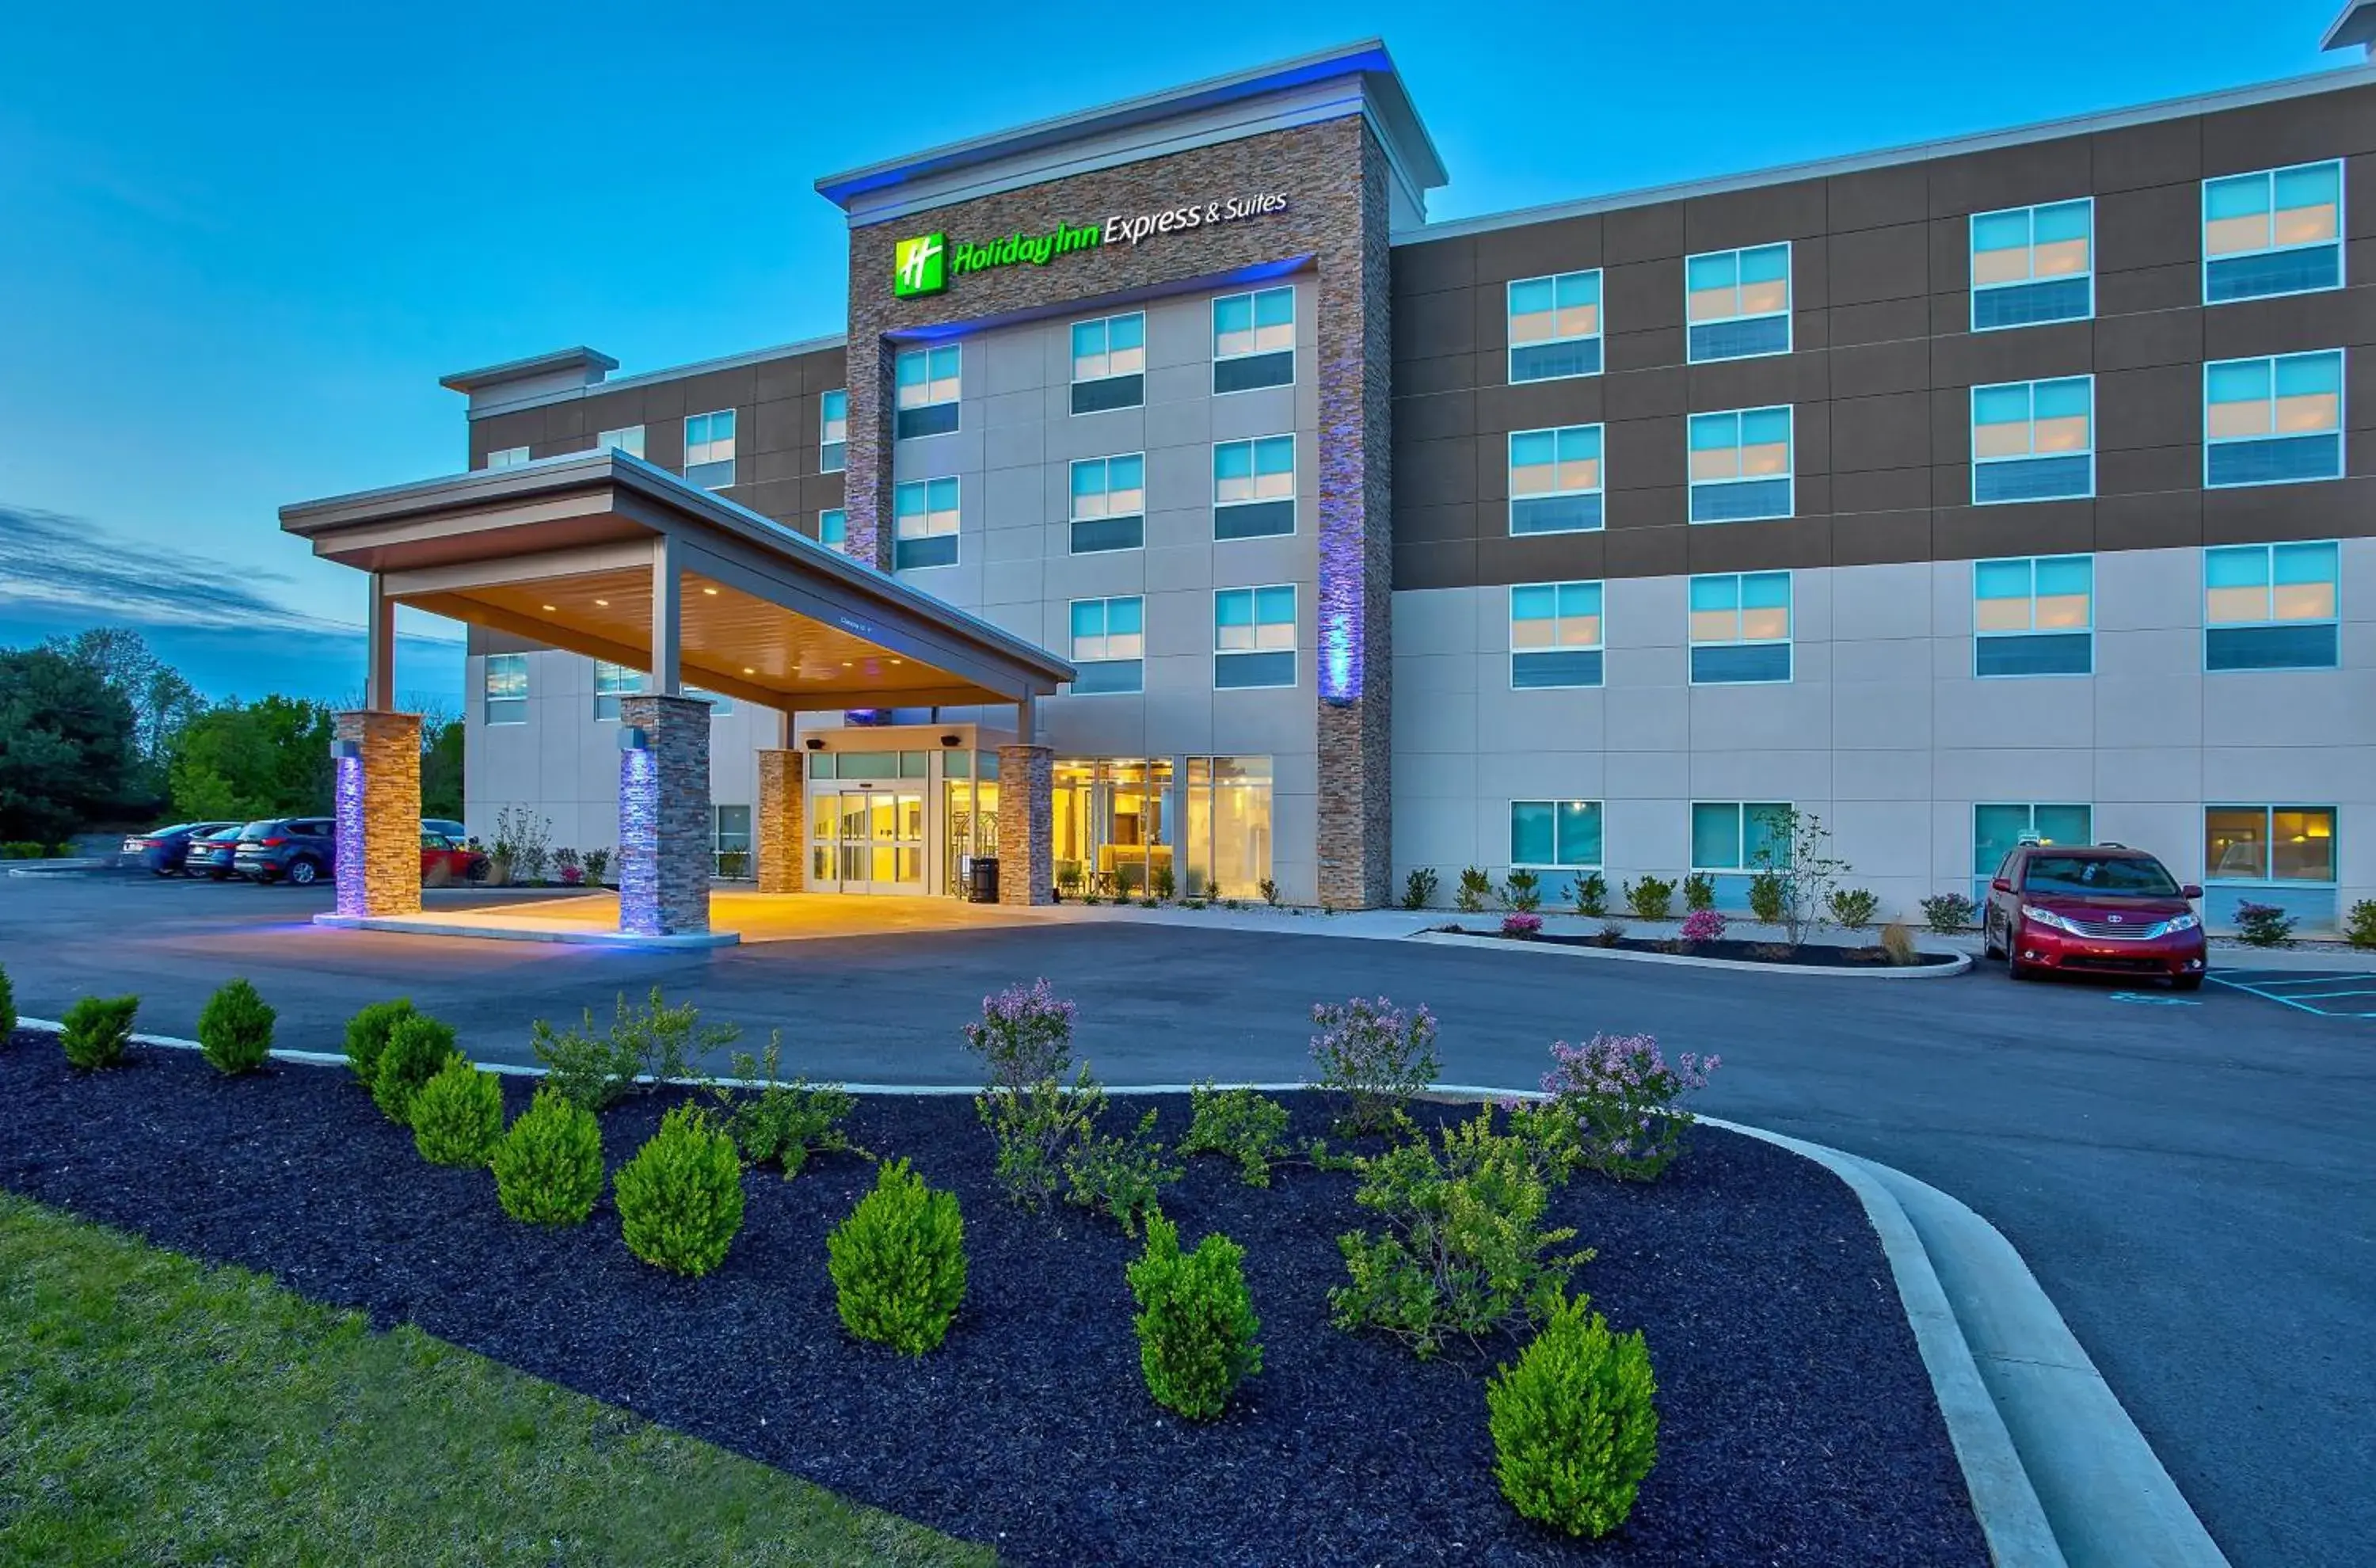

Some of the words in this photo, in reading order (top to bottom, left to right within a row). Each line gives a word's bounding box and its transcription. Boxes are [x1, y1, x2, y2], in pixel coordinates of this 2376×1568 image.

[953, 232, 1053, 274] Holiday
[1056, 221, 1100, 254] Inn
[1104, 205, 1201, 244] Express
[1205, 202, 1220, 223] &
[1224, 192, 1287, 219] Suites
